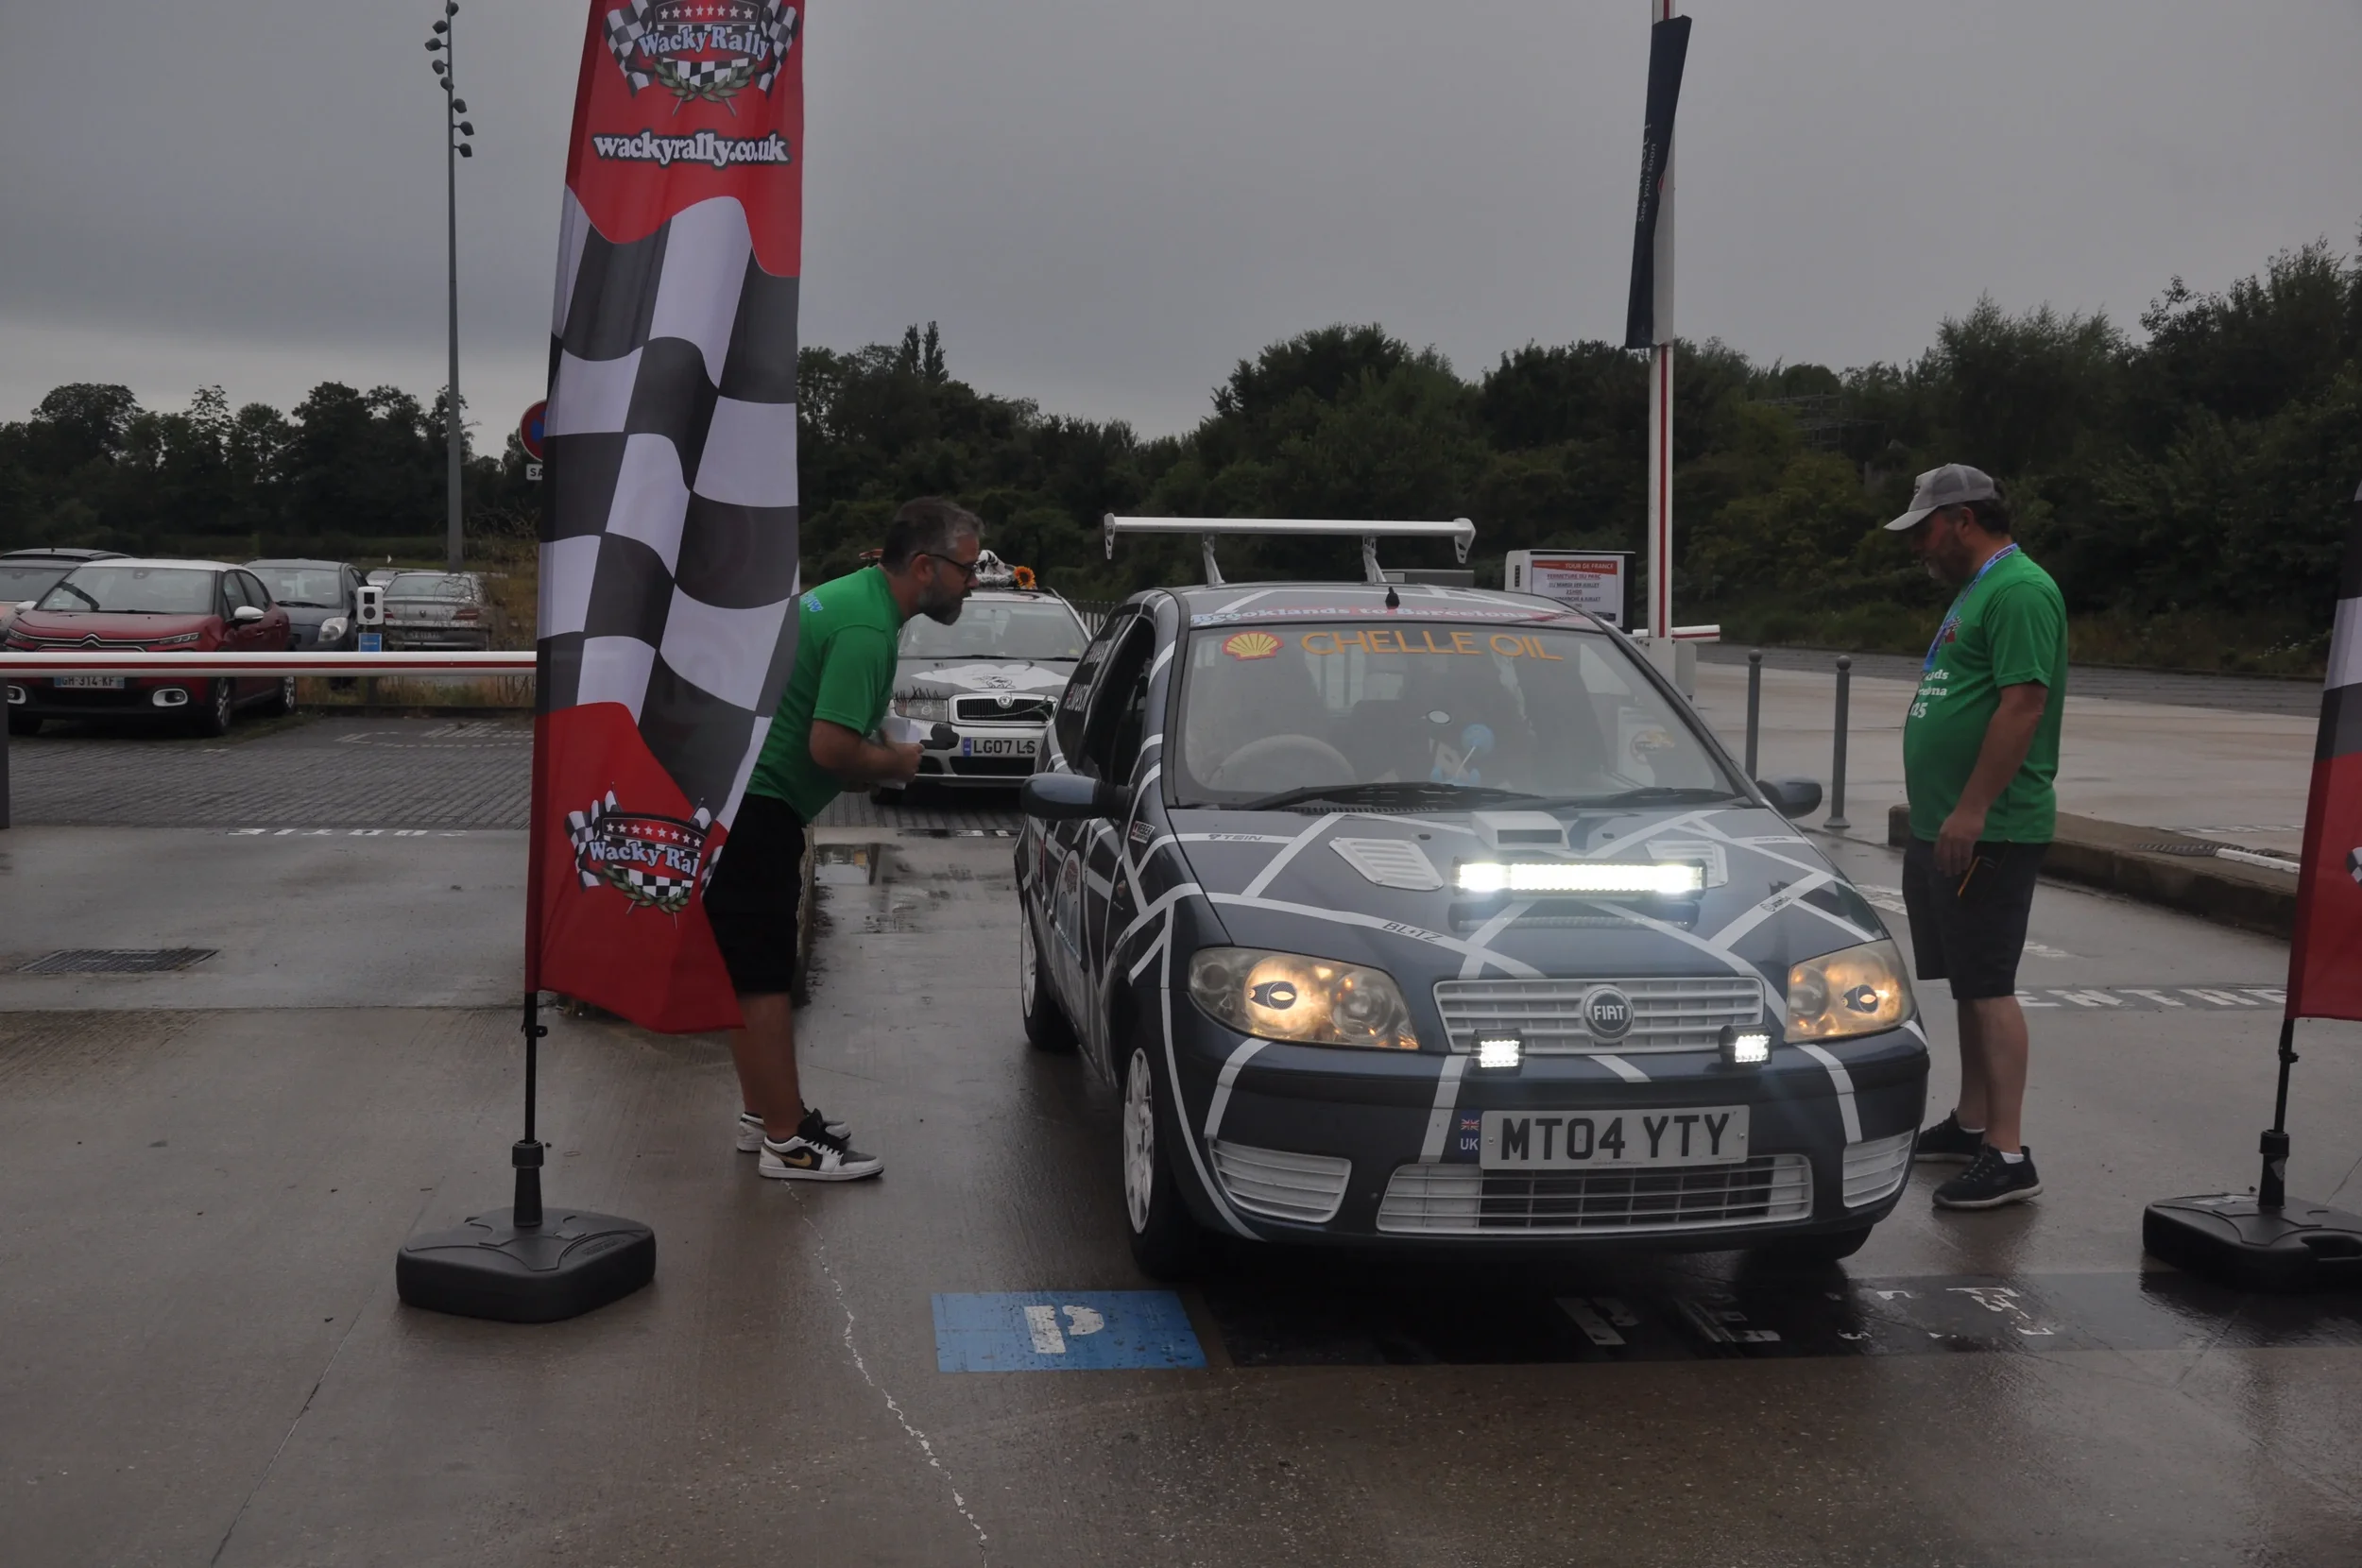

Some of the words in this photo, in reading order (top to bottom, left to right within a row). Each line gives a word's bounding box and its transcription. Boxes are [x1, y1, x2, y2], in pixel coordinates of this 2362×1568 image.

[638, 26, 709, 57] Wacky
[710, 26, 770, 60] Rally
[592, 131, 789, 166] wackyrally.co.uk
[1301, 630, 1484, 656] CHELLE
[1489, 634, 1564, 660] OIL
[973, 740, 1012, 754] LG07
[589, 841, 660, 866] Wacky
[665, 846, 700, 878] Ral
[1593, 1005, 1624, 1020] FIAT
[1460, 1138, 1479, 1151] UK
[1500, 1116, 1625, 1161] MT04
[1643, 1113, 1730, 1159] YTY
[1024, 1305, 1104, 1354] P
